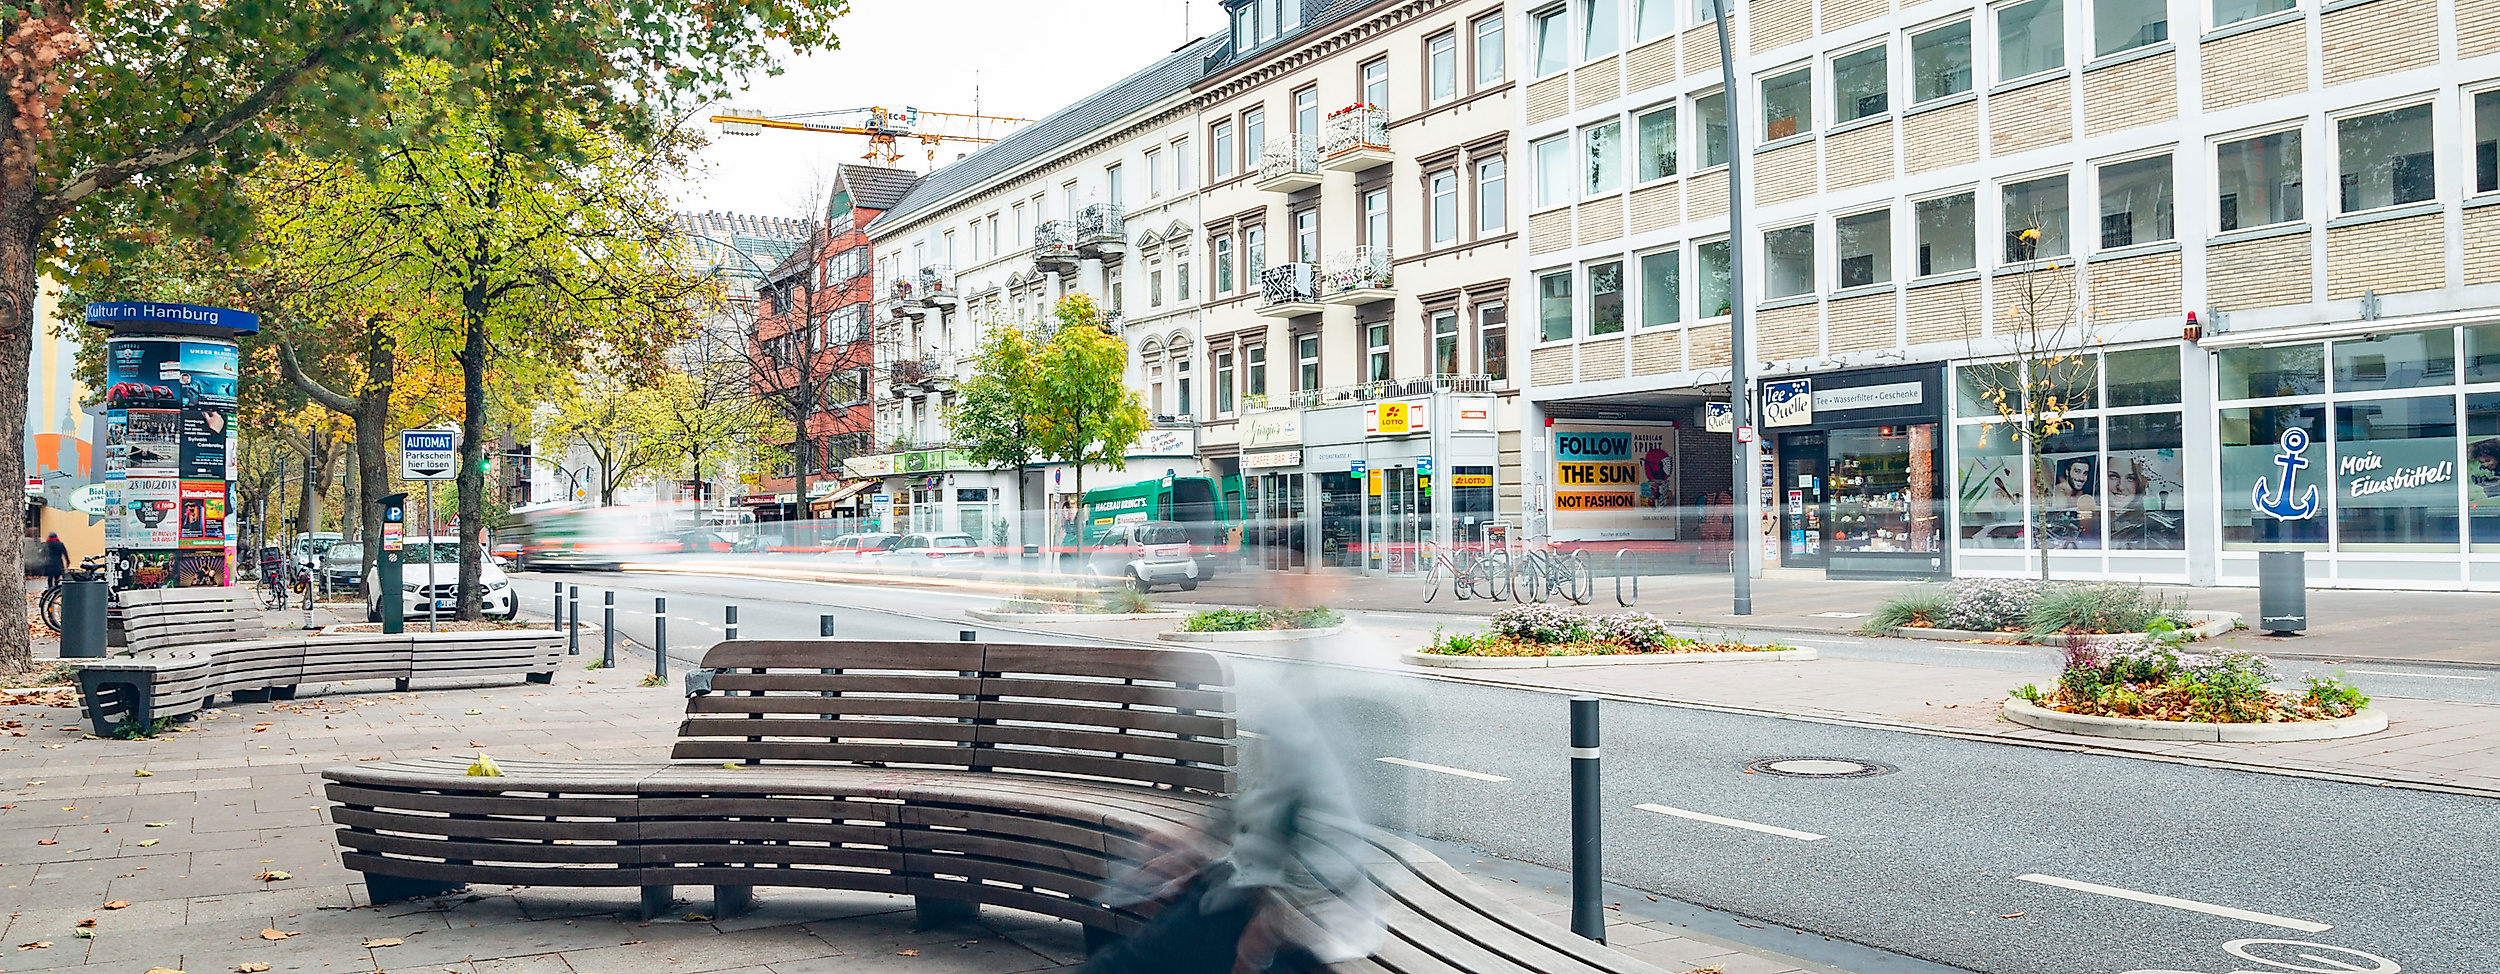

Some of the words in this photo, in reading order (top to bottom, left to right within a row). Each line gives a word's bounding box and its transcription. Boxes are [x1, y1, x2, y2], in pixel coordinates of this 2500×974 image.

[88, 304, 118, 317] Kultur
[123, 304, 136, 317] in
[143, 304, 219, 325] Hamburg
[1766, 385, 1785, 402] Tee
[1816, 397, 1828, 405] Tee
[1833, 393, 1873, 404] Wasserfilter
[1879, 389, 1919, 400] Geschenke
[1708, 404, 1720, 416] Tee
[1768, 396, 1808, 422] Quelle
[406, 436, 451, 448] AUTOMAT
[1150, 431, 1173, 443] Damen
[1559, 436, 1629, 456] FOLLOW
[1634, 441, 1663, 453] SPIRIT
[405, 451, 452, 460] Parkschein
[1273, 453, 1286, 465] BAR
[427, 460, 450, 469] lösen
[2339, 450, 2383, 476] Moin
[1561, 465, 1595, 484] THE
[1599, 465, 1636, 484] SUN
[128, 480, 177, 490] 28/10/2018
[1095, 500, 1121, 512] HAGEBAU
[1557, 495, 1582, 508] NOT
[1584, 495, 1634, 508] FASHION
